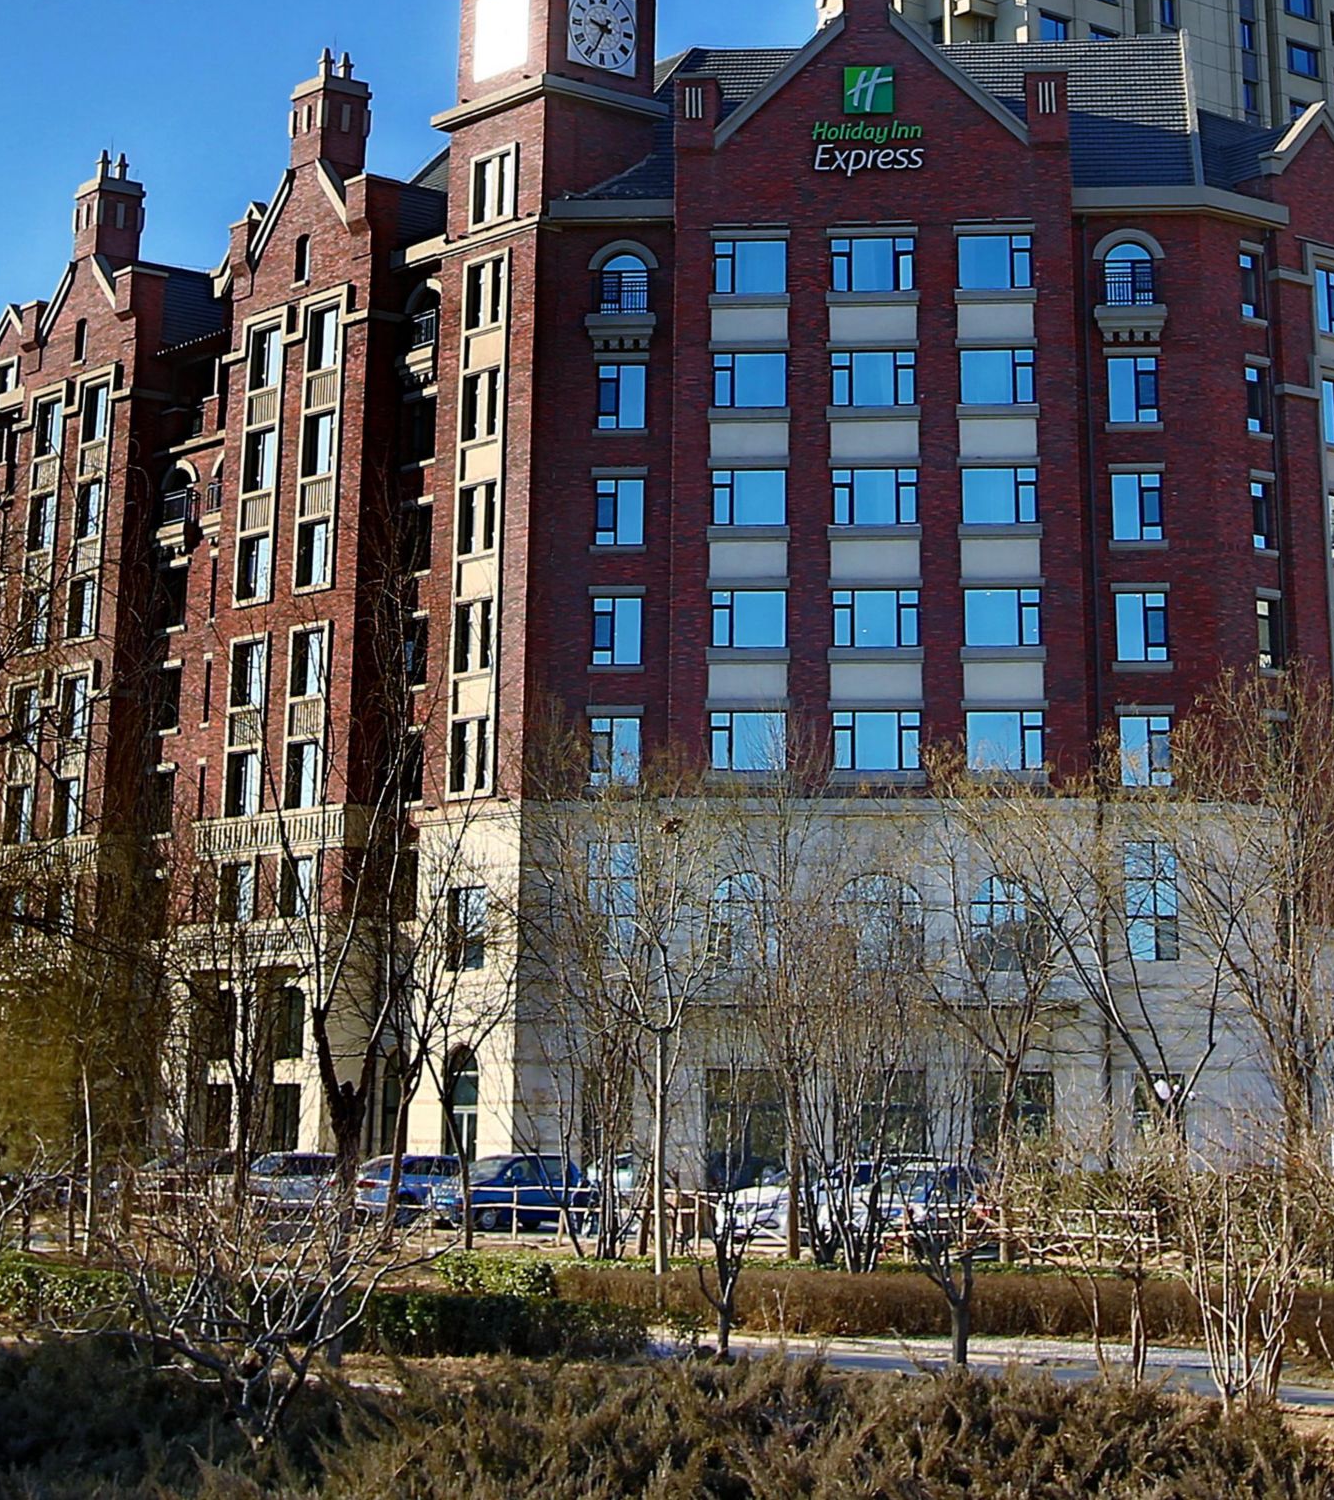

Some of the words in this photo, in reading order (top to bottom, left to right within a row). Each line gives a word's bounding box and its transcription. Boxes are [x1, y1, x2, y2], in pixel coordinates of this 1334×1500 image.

[812, 120, 888, 144] Holiday
[890, 119, 923, 139] Inn
[814, 143, 925, 177] Express
